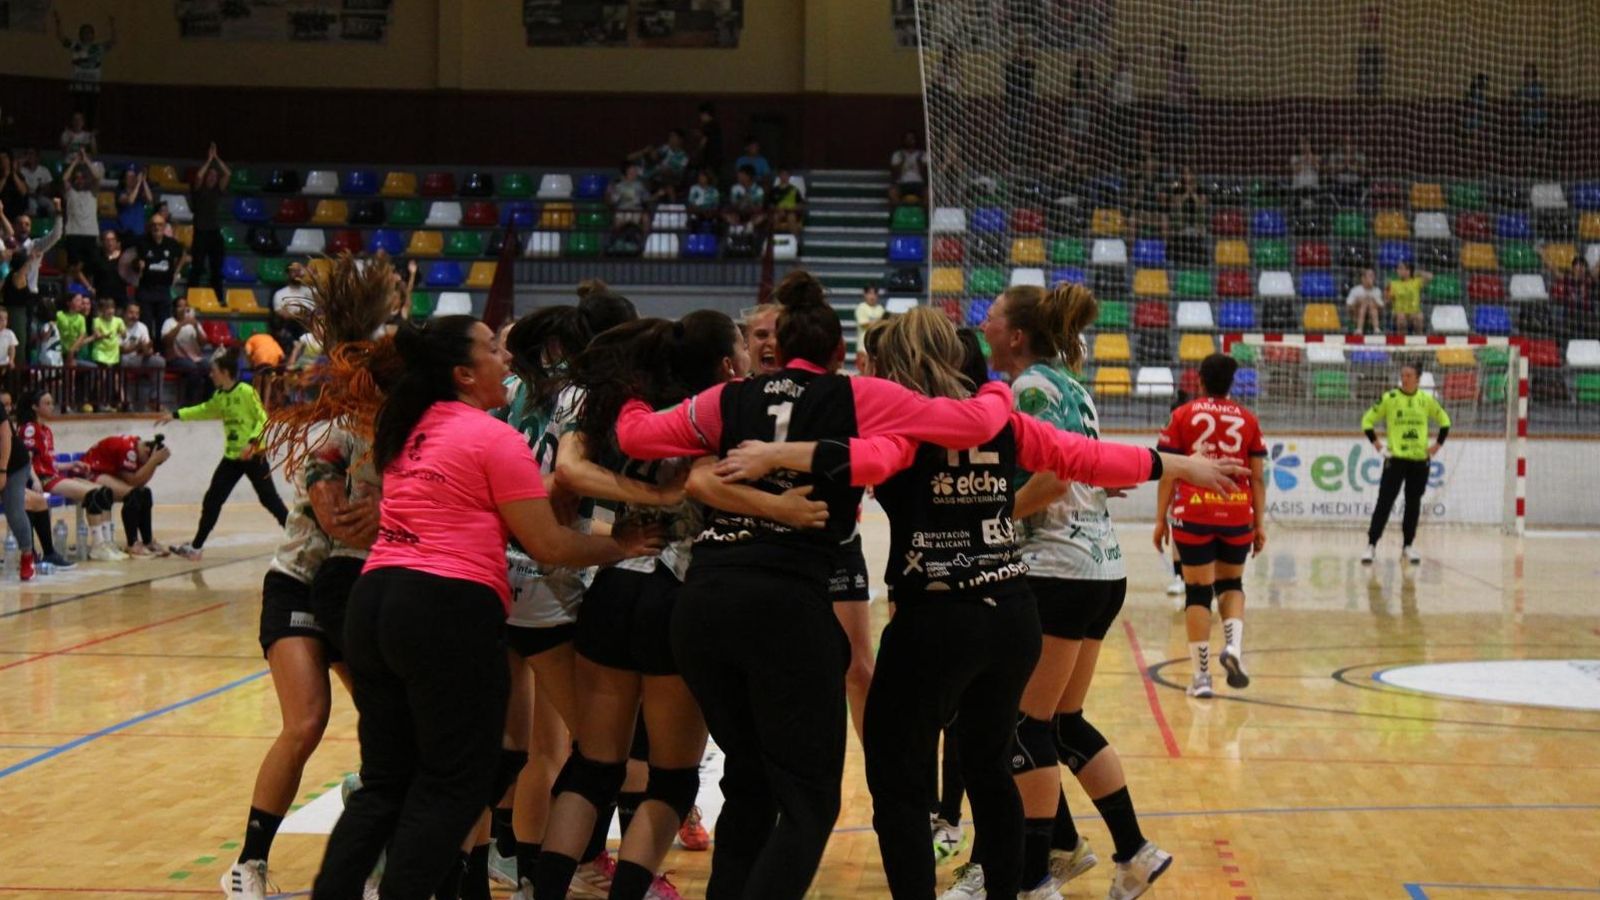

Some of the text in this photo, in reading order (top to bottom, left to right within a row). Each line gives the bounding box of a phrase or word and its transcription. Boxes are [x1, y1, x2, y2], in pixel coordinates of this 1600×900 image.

[1191, 412, 1245, 453] 23
[1311, 444, 1446, 493] elce
[956, 470, 1007, 495] elche
[1311, 501, 1446, 516] MEDITEEO
[924, 530, 971, 541] DIPUTACIÓN
[935, 540, 972, 548] ALICANTE
